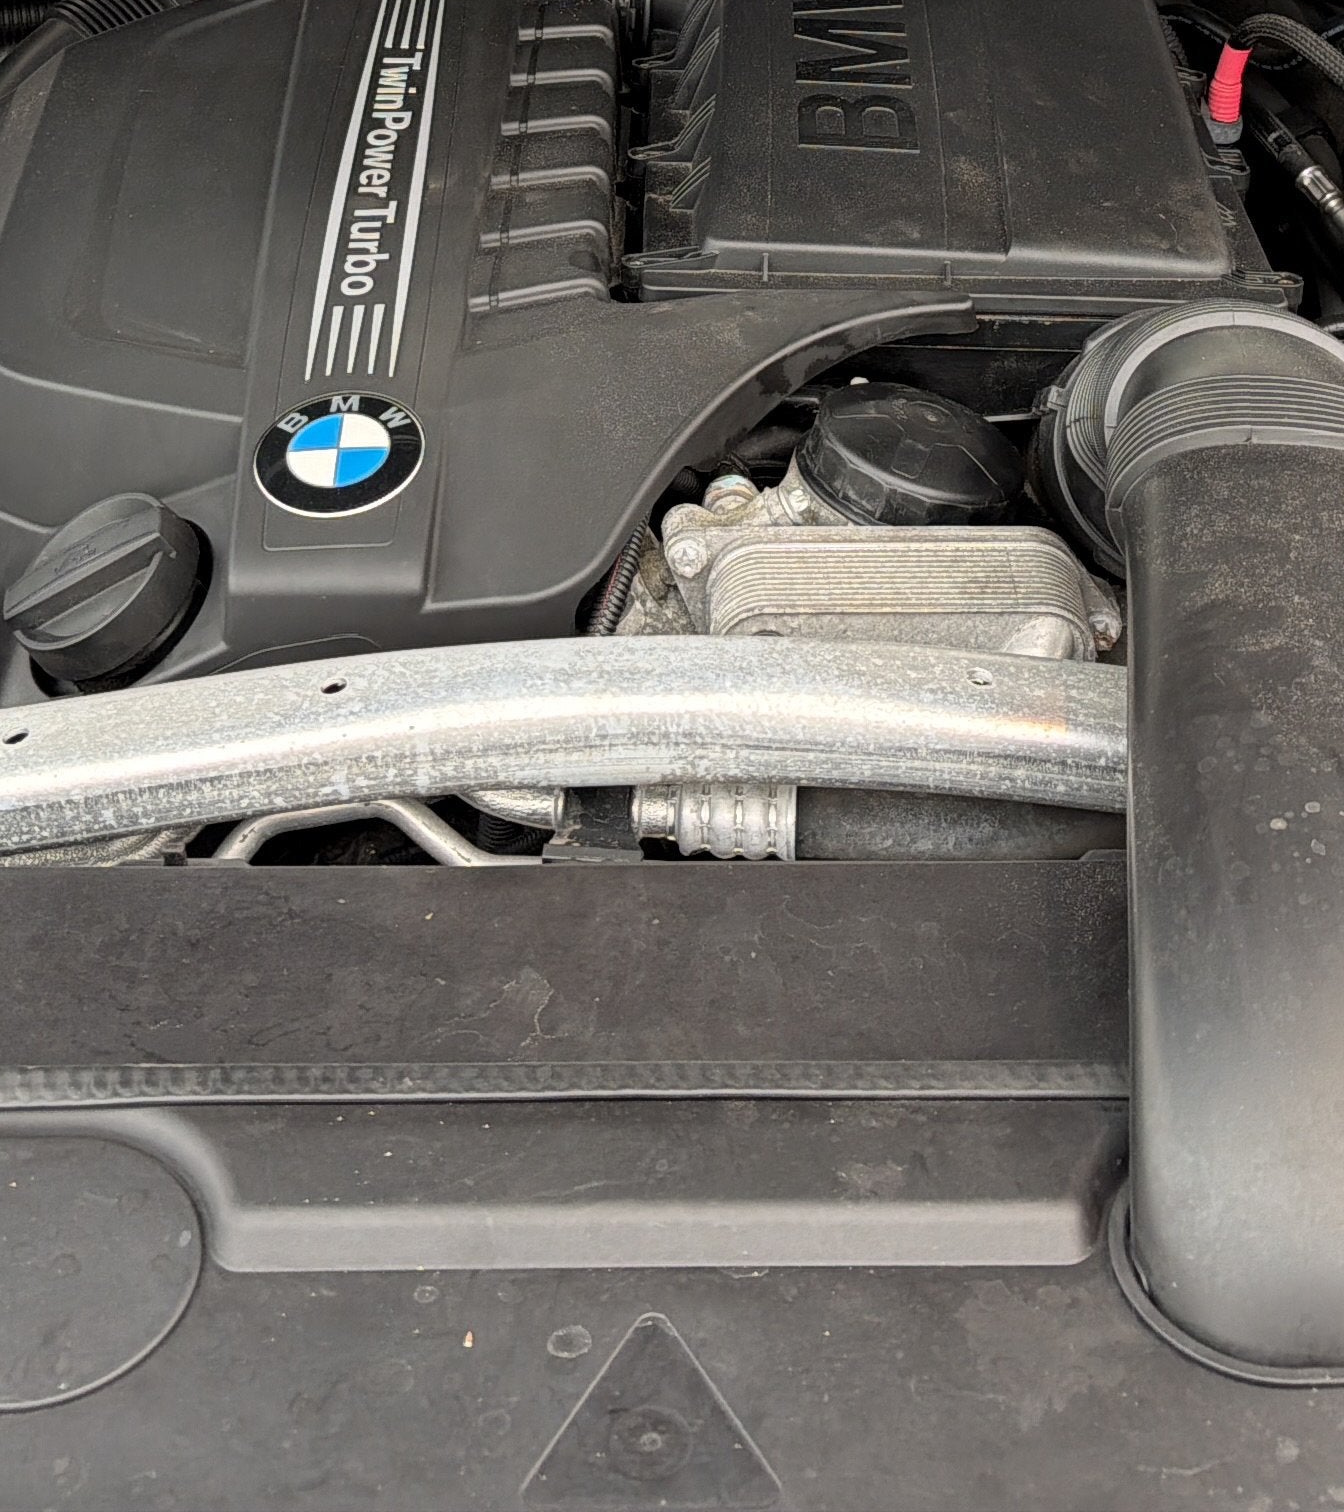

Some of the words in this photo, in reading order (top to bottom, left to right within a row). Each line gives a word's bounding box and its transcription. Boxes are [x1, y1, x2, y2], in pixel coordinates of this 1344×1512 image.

[358, 51, 423, 198] TwinPower
[340, 200, 398, 296] Turbo
[277, 394, 412, 434] BMW
